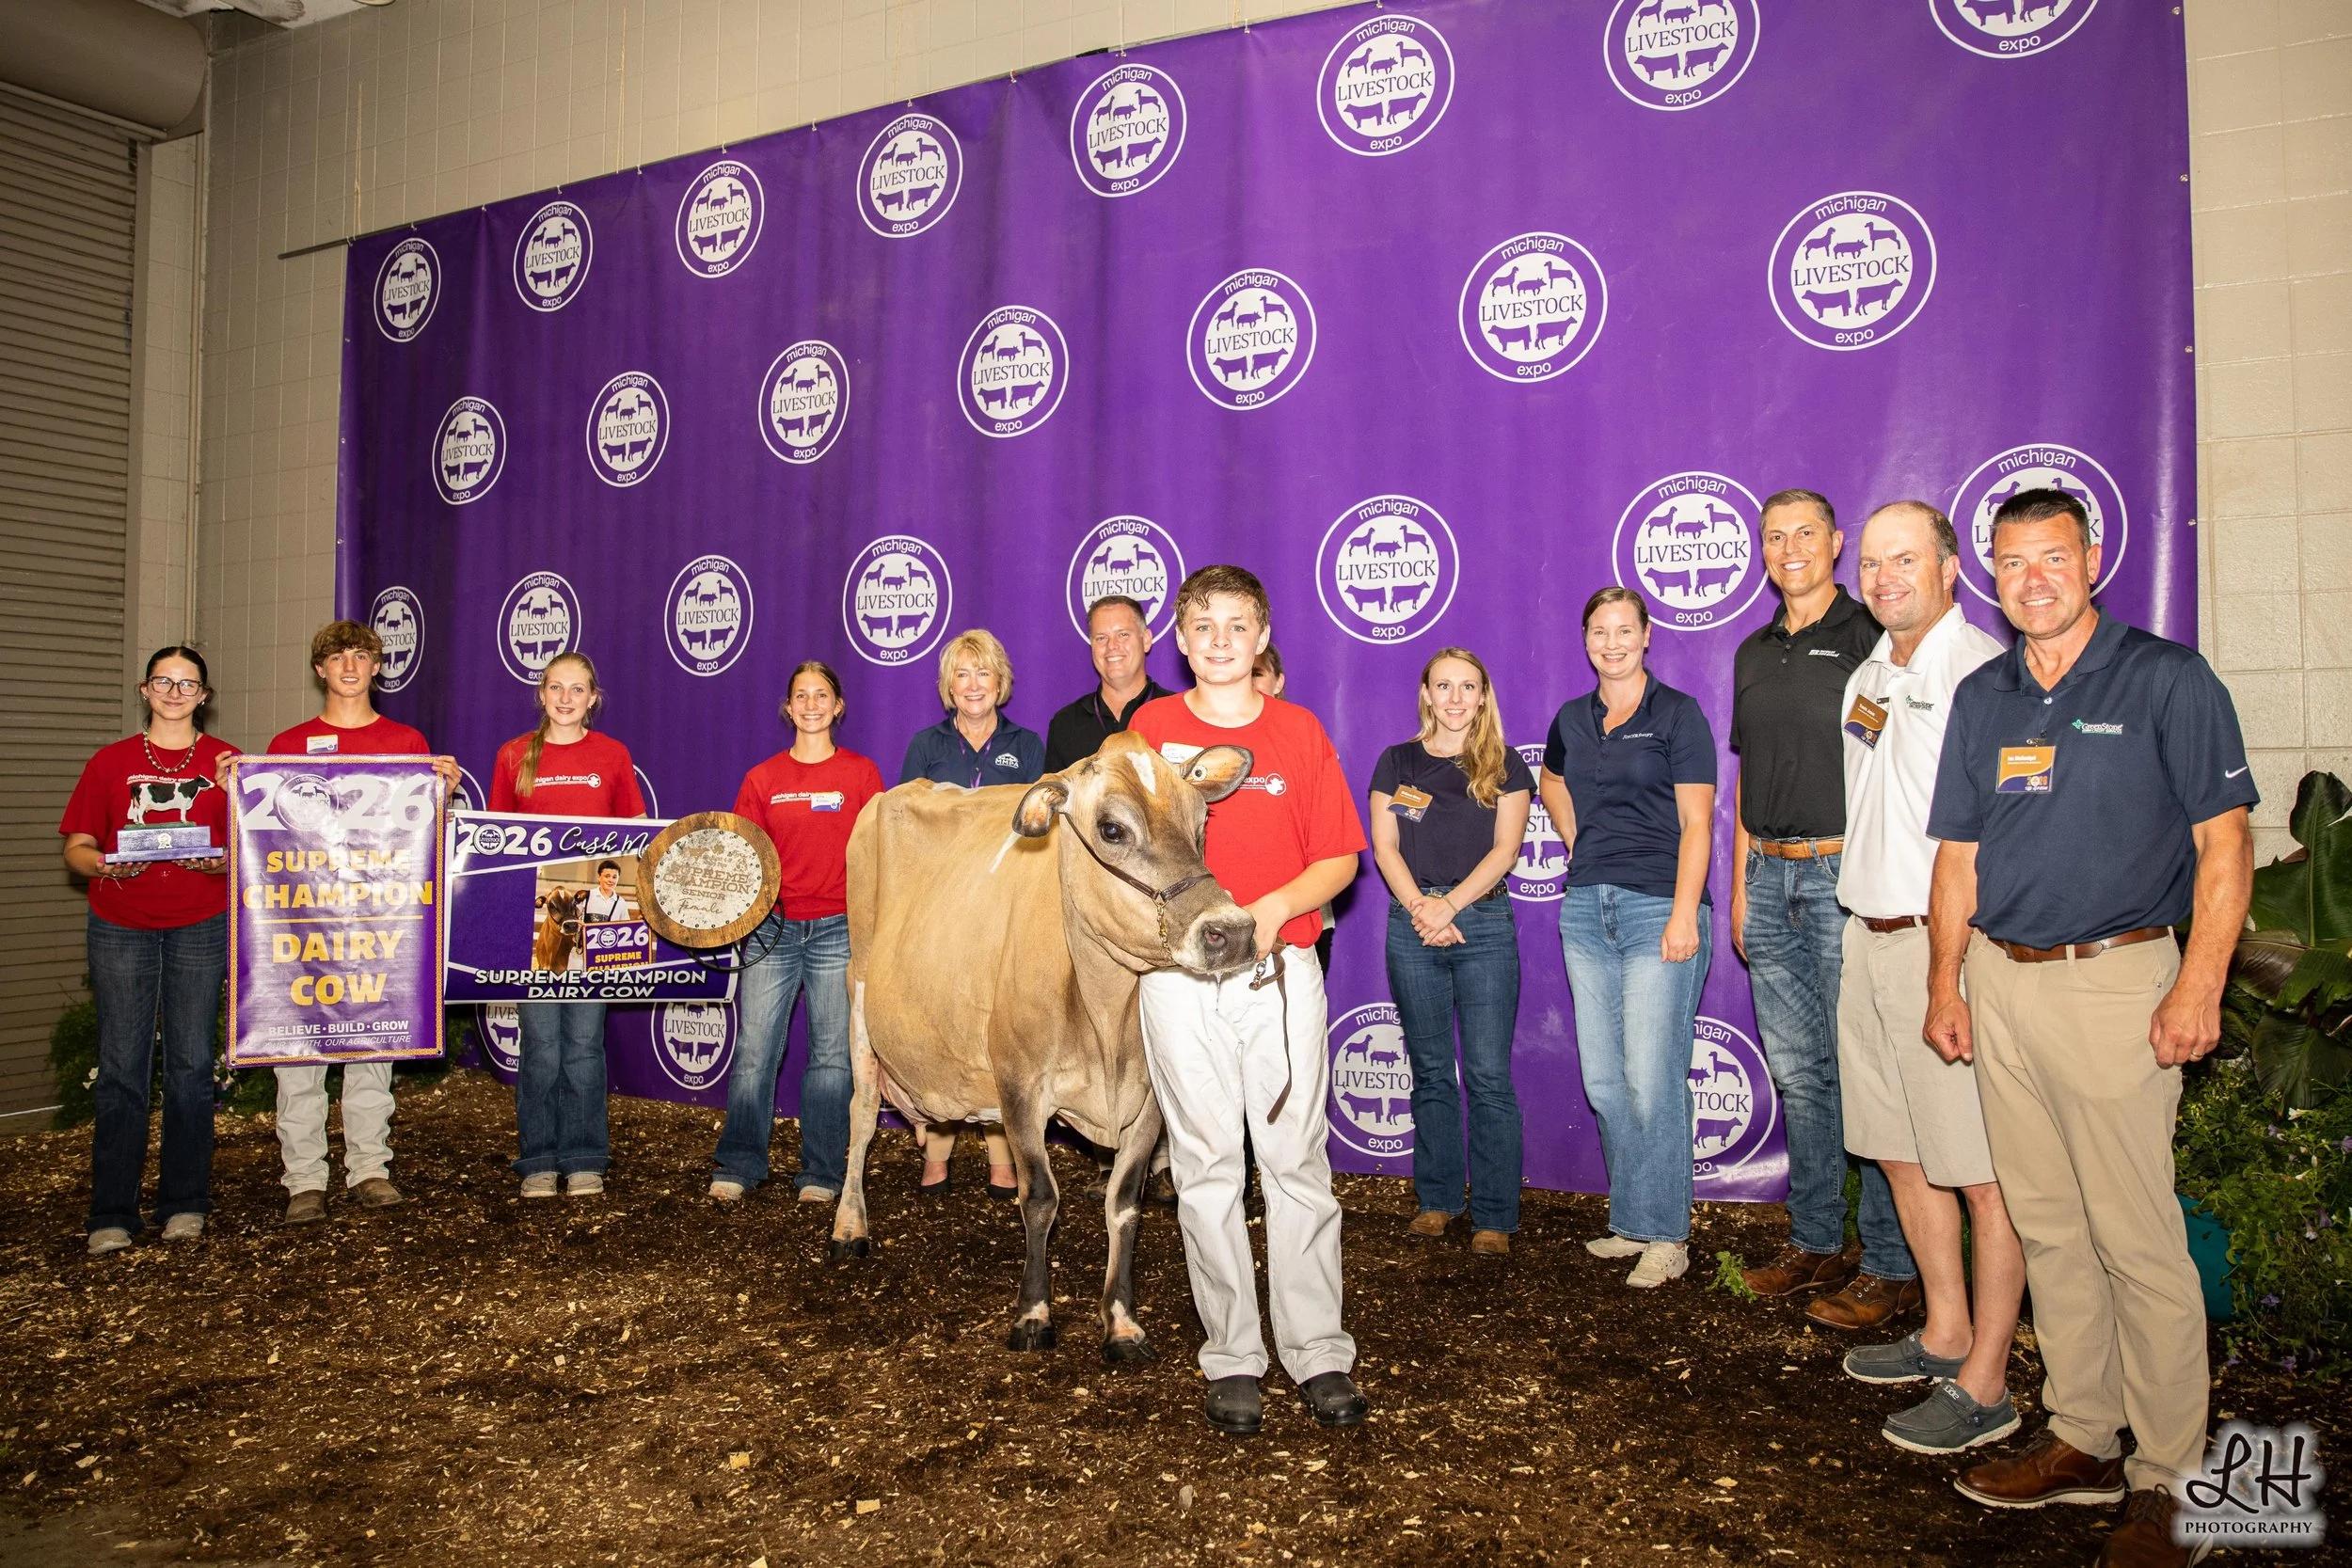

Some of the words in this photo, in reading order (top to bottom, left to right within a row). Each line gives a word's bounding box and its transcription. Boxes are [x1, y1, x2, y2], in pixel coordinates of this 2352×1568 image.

[1356, 17, 1415, 42] michigan
[1628, 21, 1735, 54] LIVESTOCK
[1998, 34, 2041, 54] expo
[1102, 68, 1152, 90] michigan
[1338, 71, 1432, 102] LIVESTOCK
[1665, 88, 1701, 105] expo
[887, 116, 932, 136] michigan
[1089, 117, 1167, 149] LIVESTOCK
[1370, 134, 1402, 150] expo
[703, 166, 740, 182] michigan
[871, 164, 945, 191] LIVESTOCK
[1111, 176, 1139, 193] expo
[537, 205, 573, 222] michigan
[1816, 197, 1887, 220] michigan
[689, 209, 750, 232] LIVESTOCK
[892, 219, 918, 234] expo
[394, 242, 424, 258] michigan
[525, 245, 580, 268] LIVESTOCK
[1501, 237, 1565, 261] michigan
[707, 261, 729, 274] expo
[1794, 256, 1909, 288] LIVESTOCK
[383, 279, 430, 304] LIVESTOCK
[1225, 273, 1279, 295] michigan
[543, 295, 562, 308] expo
[1481, 294, 1583, 323] LIVESTOCK
[987, 309, 1036, 328] michigan
[398, 327, 415, 340] expo
[1207, 328, 1295, 355] LIVESTOCK
[1835, 327, 1874, 346] expo
[787, 343, 827, 359] michigan
[974, 361, 1050, 387] LIVESTOCK
[1517, 360, 1551, 378] expo
[612, 377, 649, 392] michigan
[772, 391, 836, 413] LIVESTOCK
[1235, 388, 1264, 405] expo
[452, 400, 485, 415] michigan
[598, 420, 657, 440] LIVESTOCK
[994, 419, 1023, 433] expo
[442, 442, 493, 463] LIVESTOCK
[793, 446, 817, 459] expo
[1998, 449, 2076, 473] michigan
[617, 470, 637, 483] expo
[453, 489, 470, 501] expo
[1658, 476, 1727, 499] michigan
[1359, 499, 1419, 519] michigan
[1098, 520, 1149, 539] michigan
[871, 539, 922, 558] michigan
[1636, 541, 1747, 566] LIVESTOCK
[691, 560, 729, 576] michigan
[1338, 561, 1436, 580] LIVESTOCK
[524, 577, 560, 591] michigan
[1084, 577, 1164, 597] LIVESTOCK
[381, 591, 411, 605] michigan
[857, 593, 934, 611] LIVESTOCK
[677, 608, 739, 625] LIVESTOCK
[1676, 609, 1713, 626] expo
[511, 620, 568, 637] LIVESTOCK
[1372, 624, 1406, 639] expo
[880, 647, 907, 662] expo
[697, 660, 719, 673] expo
[384, 676, 401, 689] expo
[559, 826, 617, 854] Cash
[266, 850, 410, 873] SUPREME
[671, 863, 749, 883] SUPREME
[663, 874, 749, 894] CHAMPION
[1519, 882, 1555, 898] expo
[243, 881, 433, 909] CHAMPION
[682, 888, 725, 900] SENIOR
[678, 898, 723, 914] Female
[272, 930, 405, 963] DAIRY
[595, 952, 642, 963] SUPREME
[476, 970, 580, 985] SUPREME
[587, 970, 707, 984] CHAMPION
[290, 974, 388, 1006] COW
[528, 986, 596, 999] DAIRY
[599, 987, 655, 998] COW
[486, 1006, 519, 1019] LIVES
[1356, 1006, 1401, 1026] michig
[665, 1019, 724, 1038] LIVESTOCK
[326, 1037, 345, 1047] OUR
[347, 1036, 411, 1046] AGRICULTURE
[683, 1073, 704, 1085] expo
[1334, 1070, 1412, 1090] LIVESTO
[1368, 1136, 1403, 1152] expo
[1693, 1161, 1712, 1176] po
